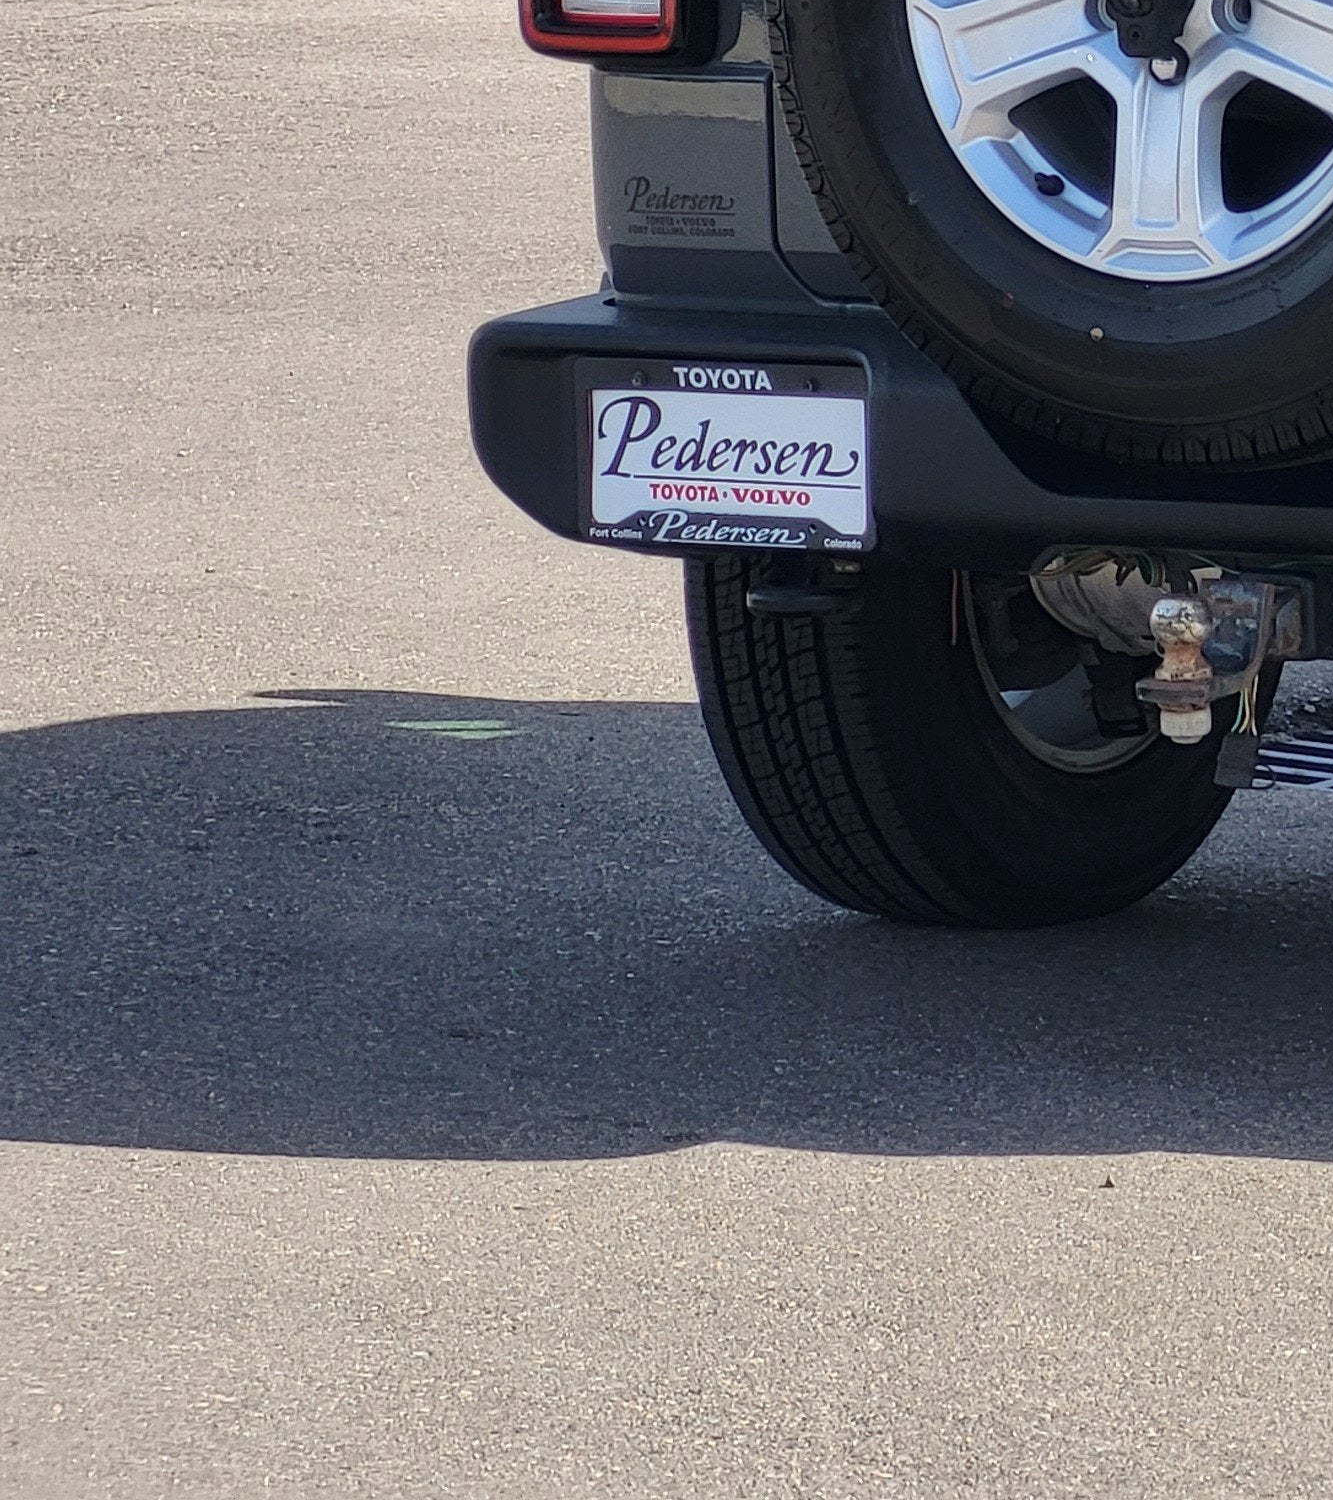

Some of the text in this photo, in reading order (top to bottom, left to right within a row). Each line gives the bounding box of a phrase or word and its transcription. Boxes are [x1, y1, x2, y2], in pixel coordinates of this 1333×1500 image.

[624, 176, 735, 212] Pedersen
[673, 366, 773, 391] TOYOTA
[598, 396, 860, 478] Pedersen
[650, 483, 811, 506] TOYOTA VOLVO
[589, 527, 643, 539] Fort Collins
[649, 509, 806, 542] Pedersen
[823, 536, 863, 550] Colorado
